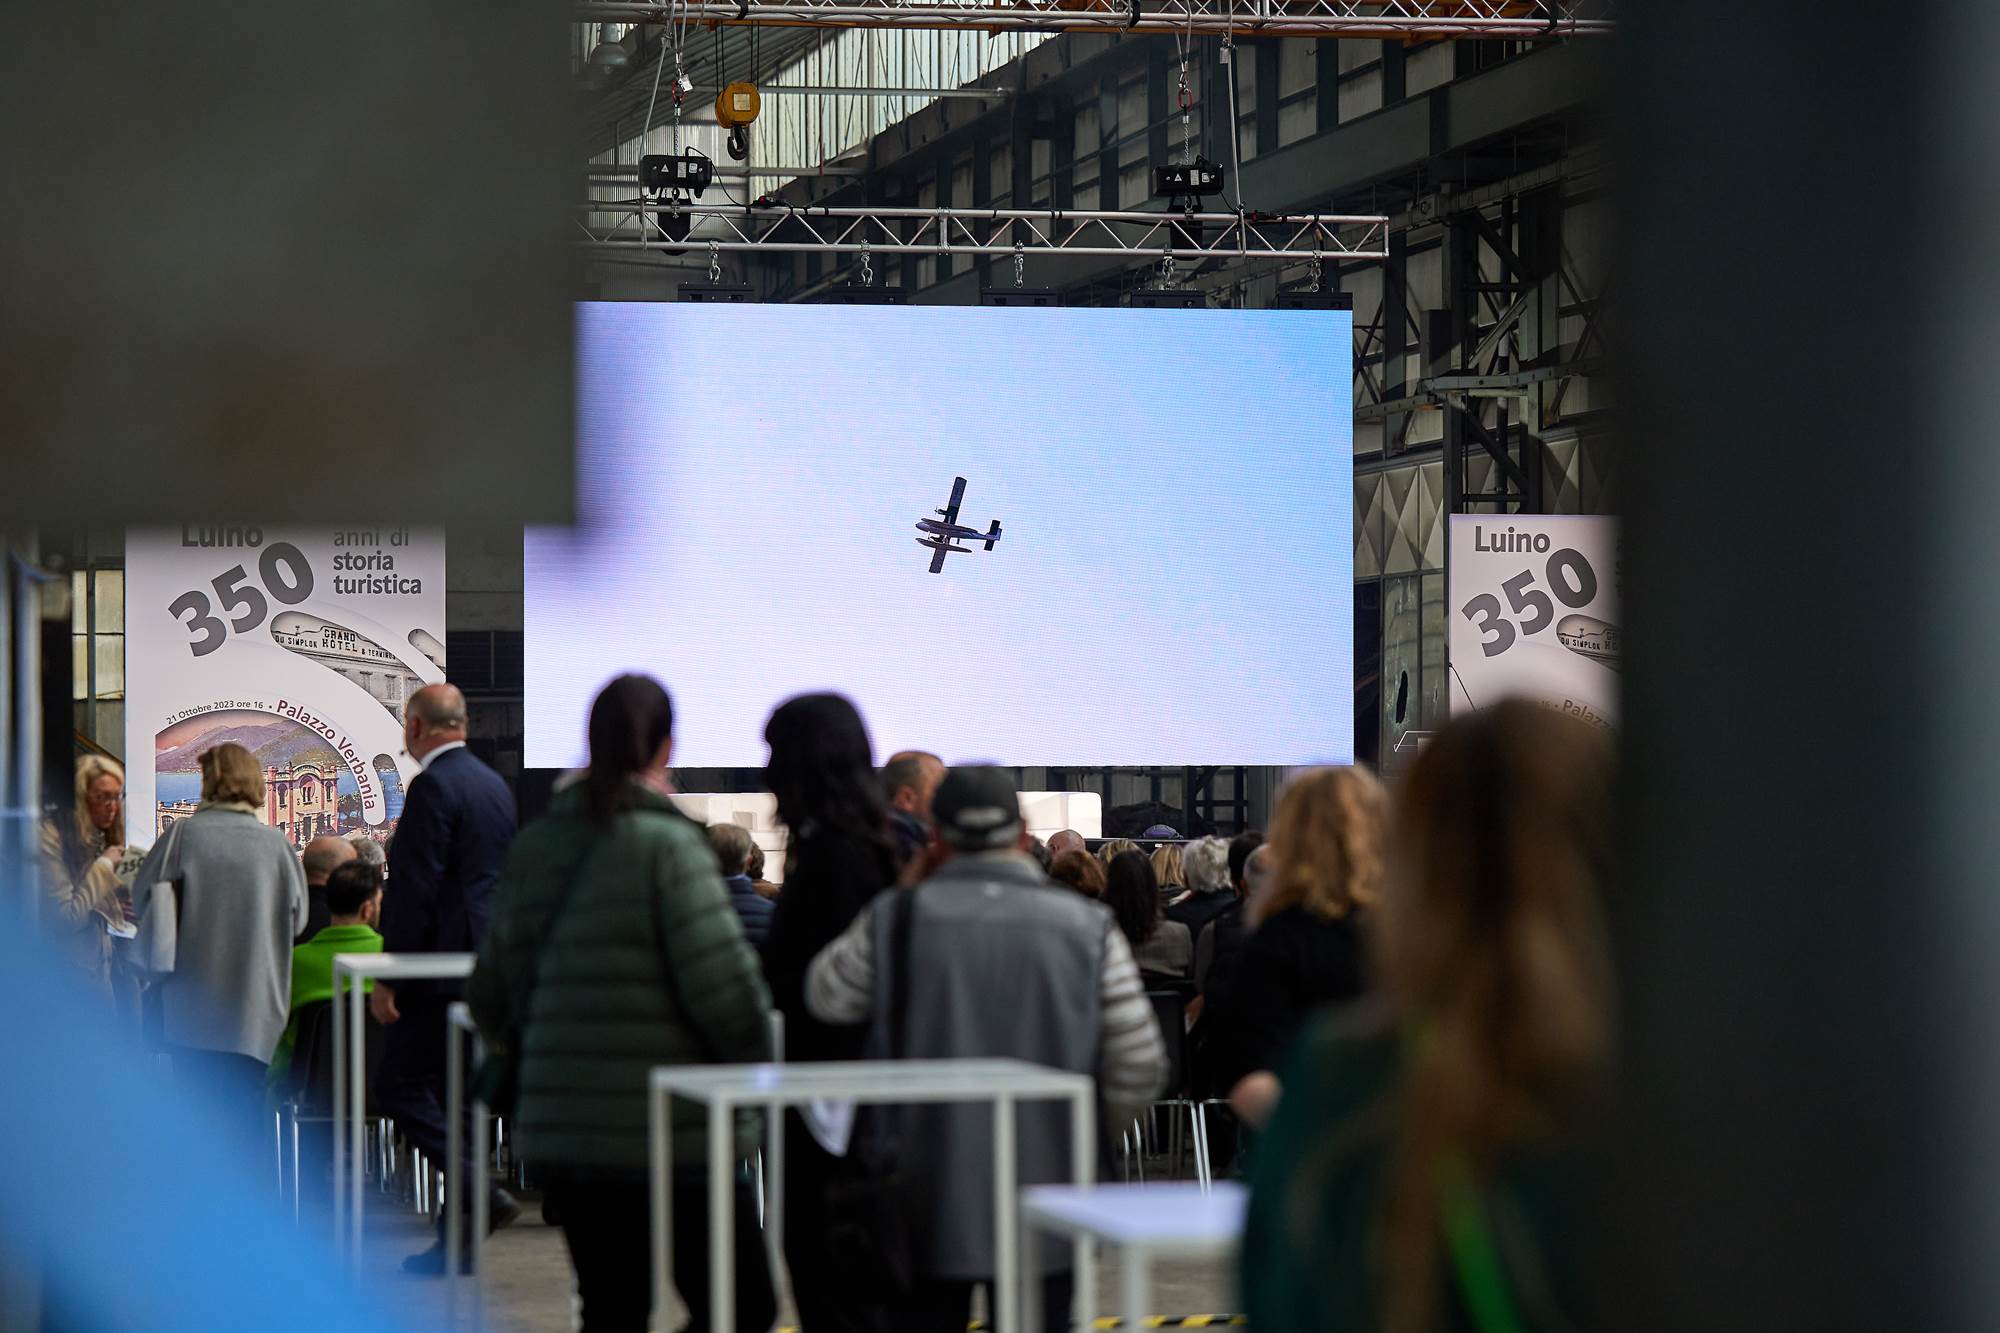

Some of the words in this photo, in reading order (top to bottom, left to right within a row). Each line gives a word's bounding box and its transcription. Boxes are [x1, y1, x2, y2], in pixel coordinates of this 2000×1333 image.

[334, 529, 380, 546] anni
[390, 528, 409, 546] di
[1475, 526, 1550, 553] Luino
[333, 551, 394, 571] storia
[333, 574, 422, 594] turistica
[168, 542, 314, 657] 350
[1461, 548, 1598, 657] 350
[322, 638, 358, 652] HOTEL
[324, 629, 356, 642] GRAND
[166, 715, 177, 725] 21
[178, 704, 212, 719] Ottobre
[214, 700, 234, 710] 2023
[254, 701, 264, 709] 16
[277, 699, 336, 740] Palazzo
[337, 736, 377, 810] Verbania
